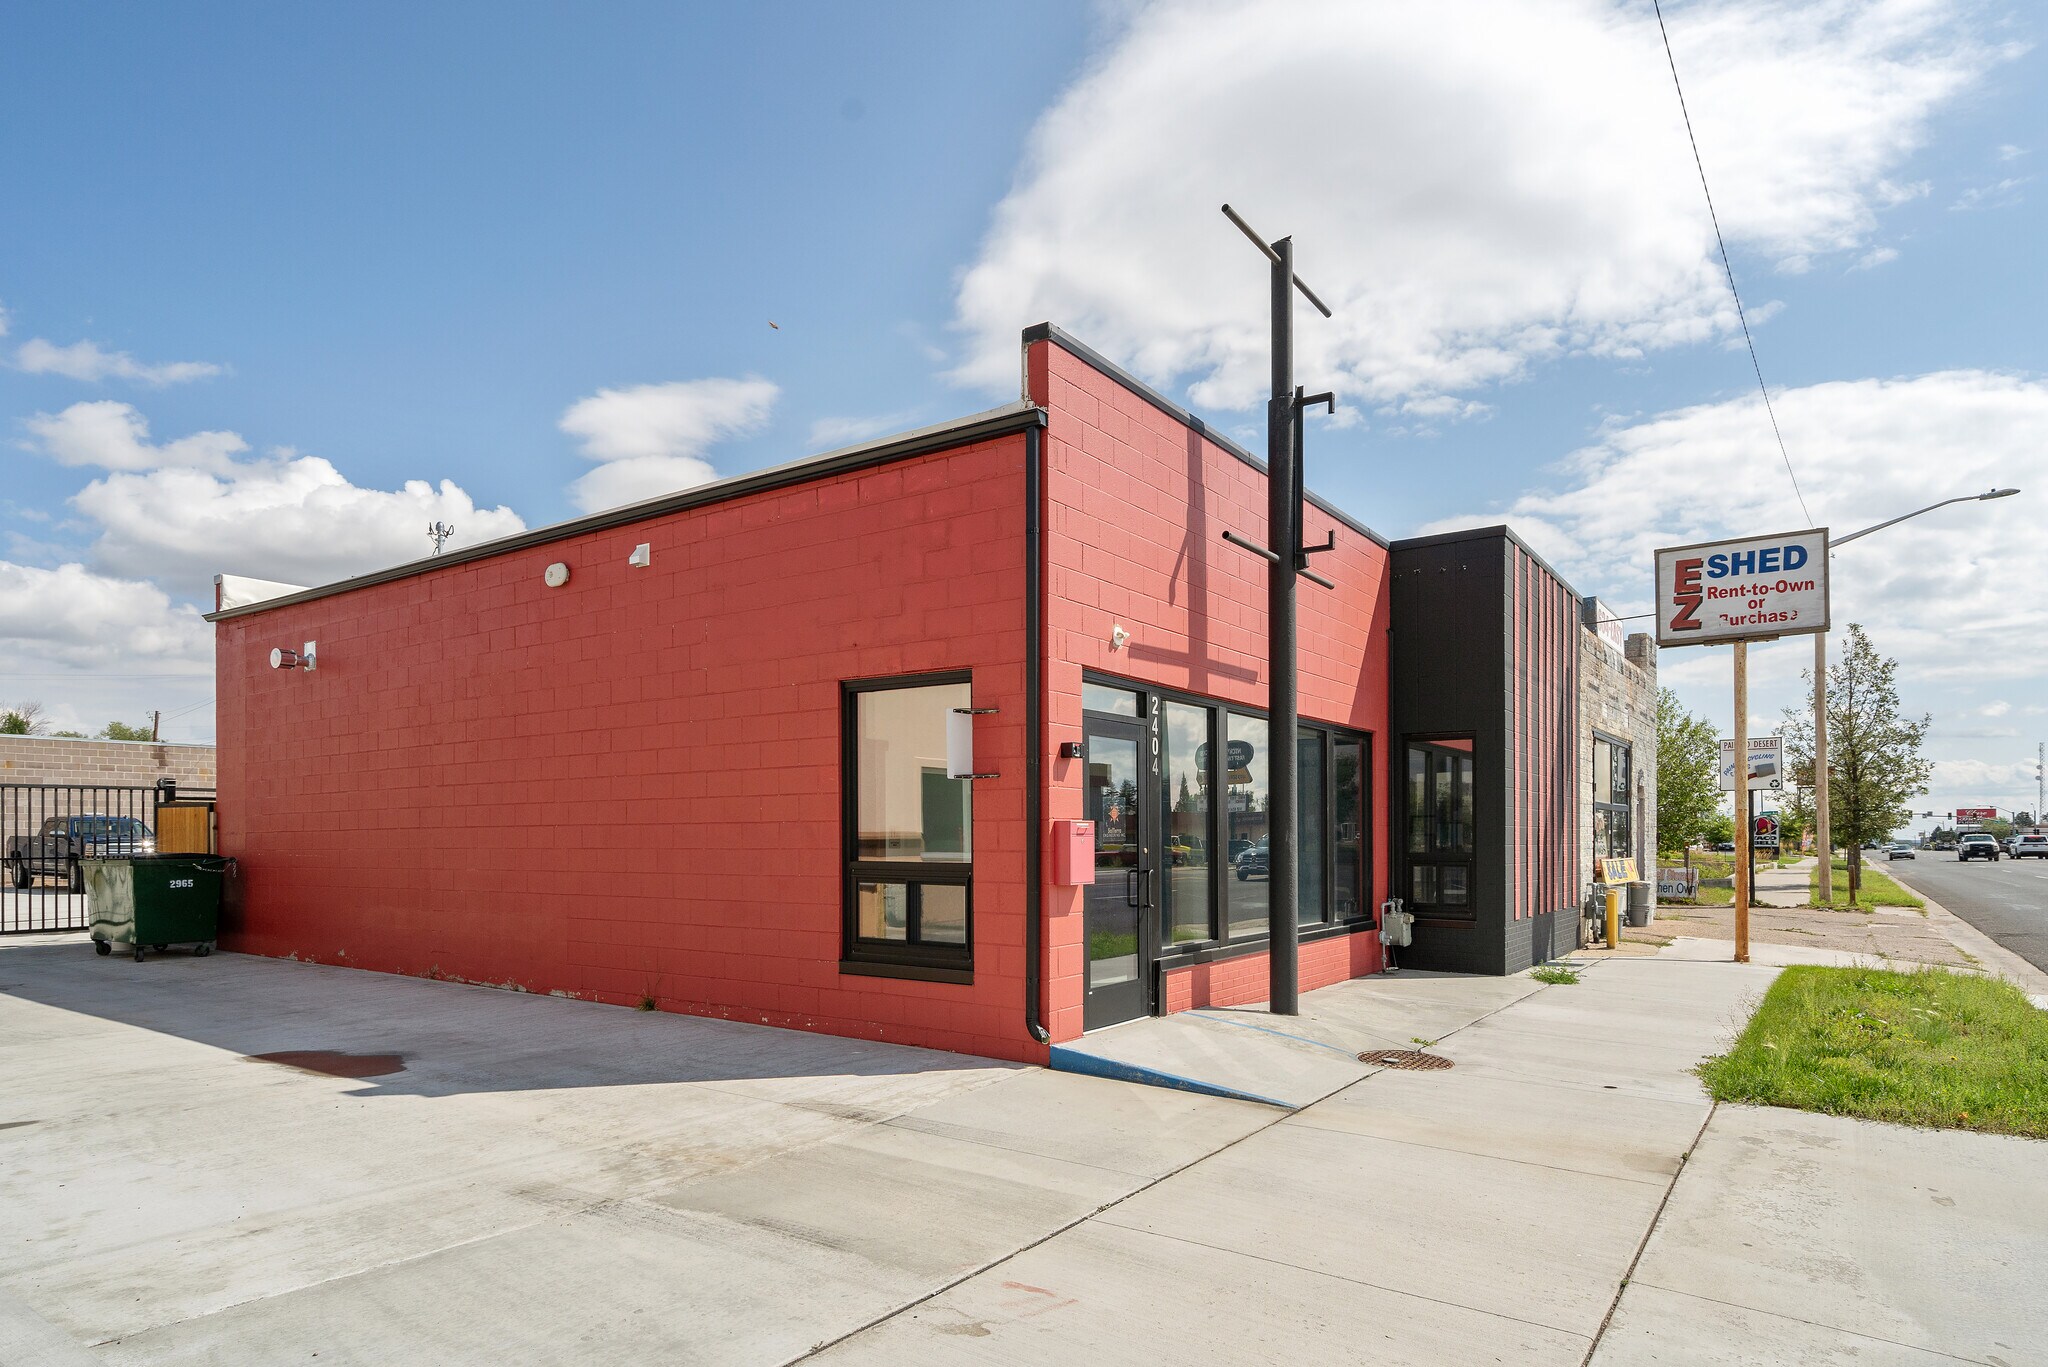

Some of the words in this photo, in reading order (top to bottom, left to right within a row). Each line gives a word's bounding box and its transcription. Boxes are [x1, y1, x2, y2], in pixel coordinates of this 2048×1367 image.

[1706, 544, 1808, 579] SHED
[1707, 579, 1815, 600] Rent-to-Own
[1747, 598, 1765, 610] or
[1151, 696, 1159, 776] 2404
[1754, 740, 1777, 748] DESERT
[169, 879, 194, 889] 2965
[1657, 882, 1674, 893] hen
